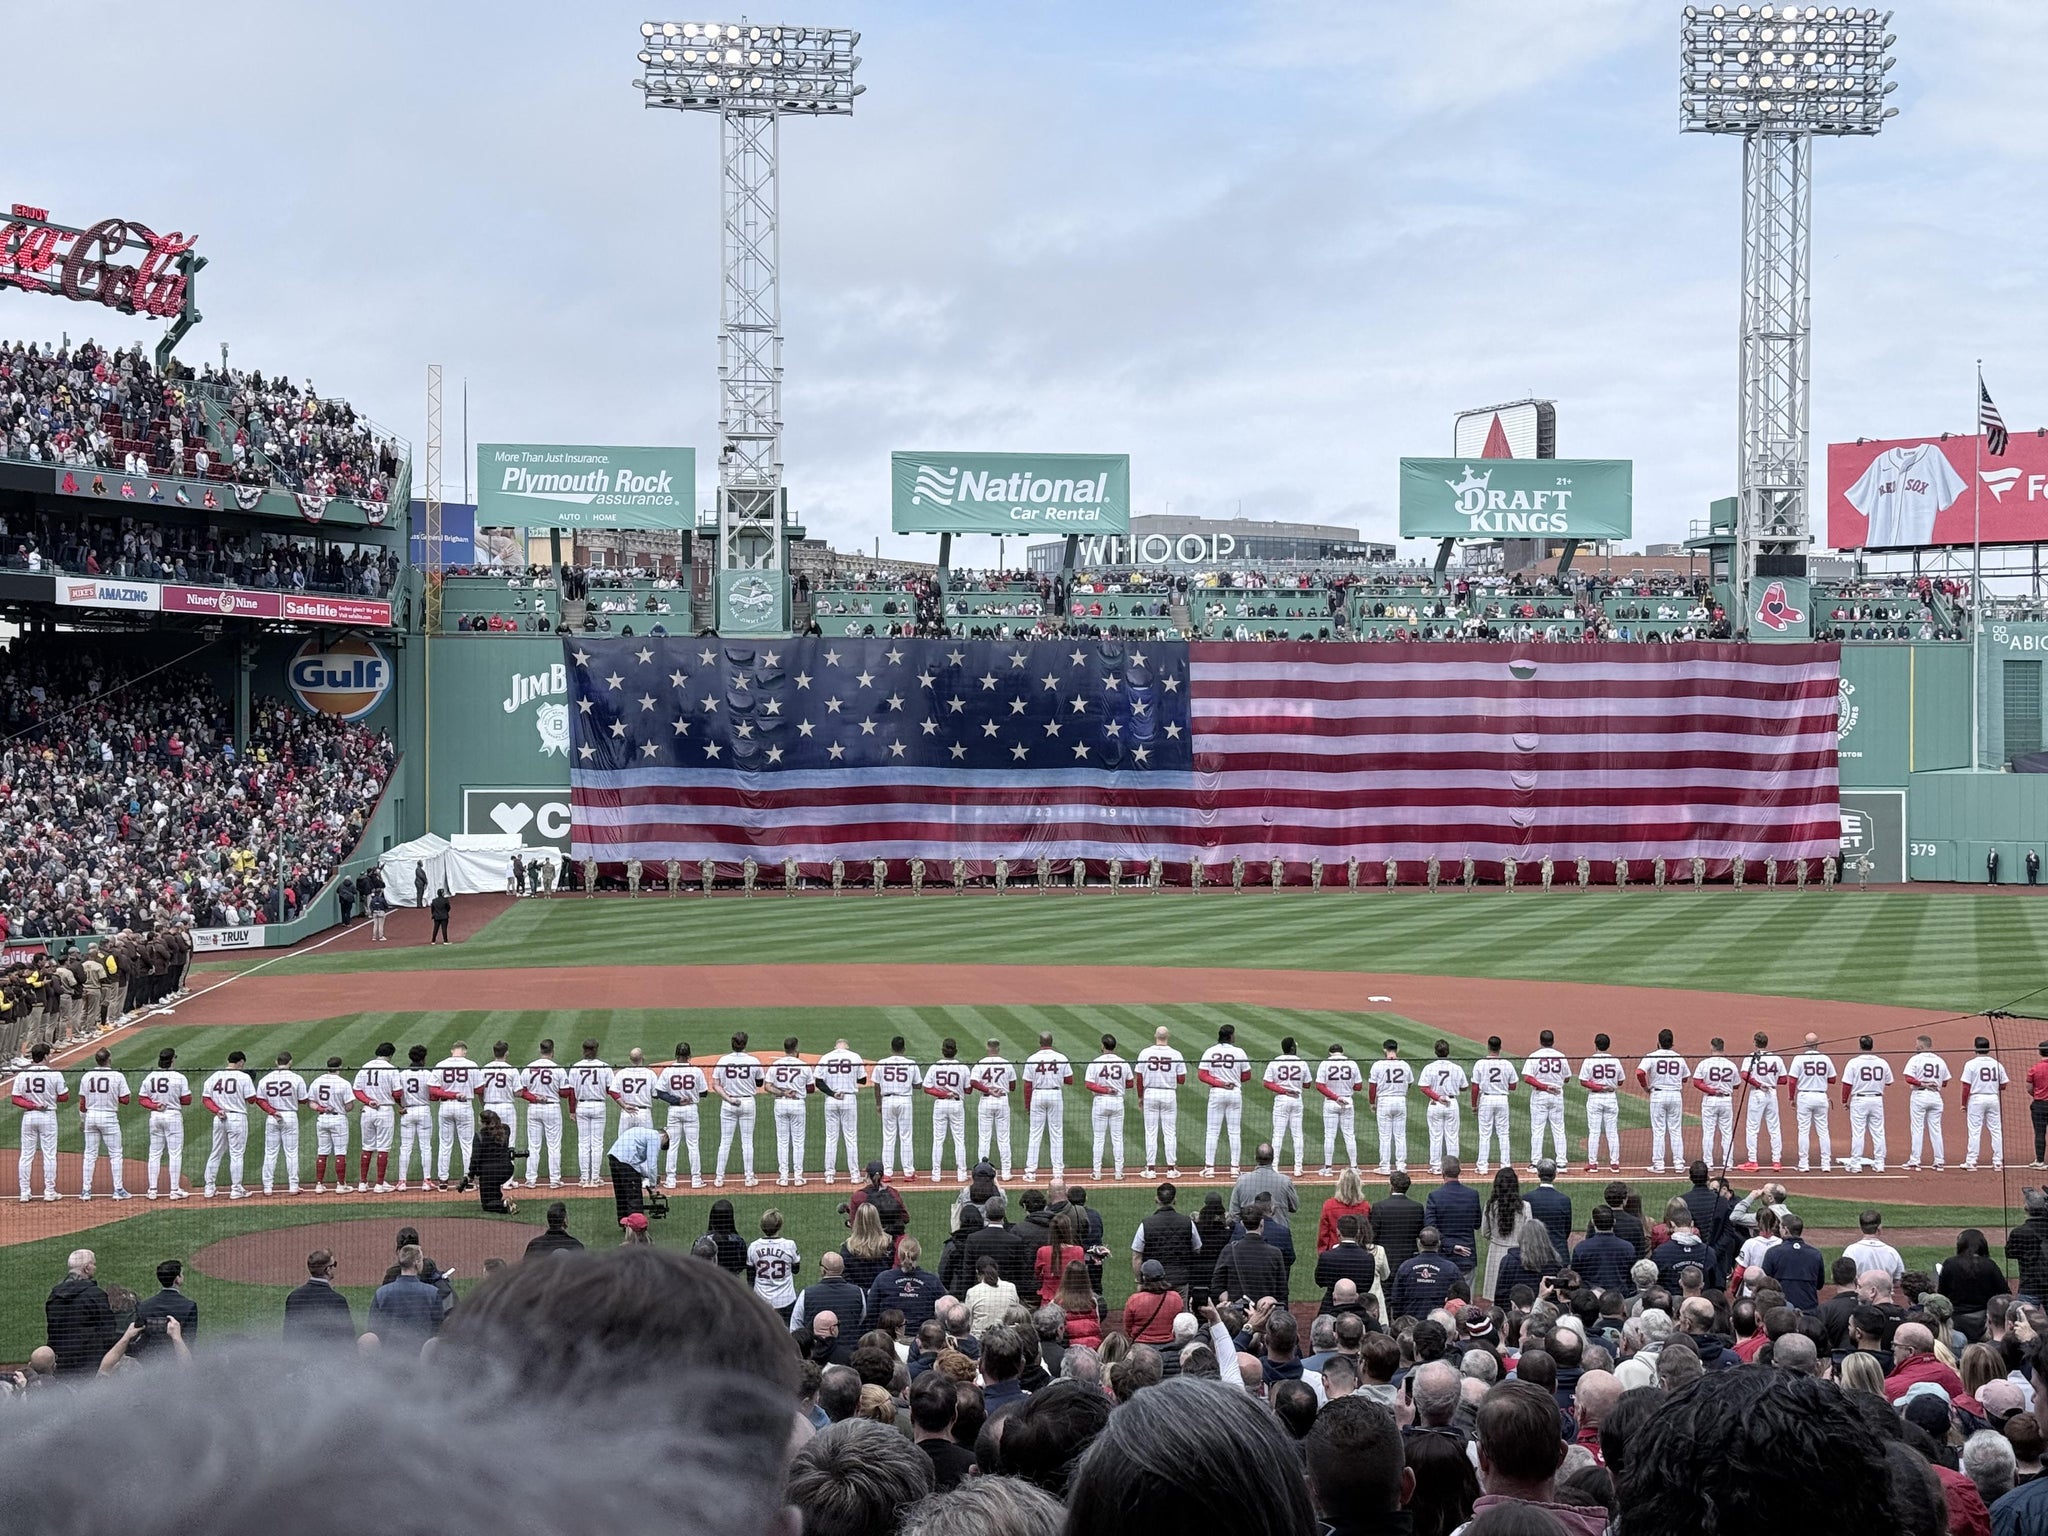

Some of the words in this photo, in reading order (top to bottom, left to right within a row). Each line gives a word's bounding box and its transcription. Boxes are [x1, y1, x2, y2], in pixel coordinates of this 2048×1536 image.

[15, 205, 49, 221] ENJOY
[495, 451, 518, 463] More
[521, 451, 543, 463] Than
[545, 452, 563, 463] Just
[565, 453, 609, 464] Insurance.
[501, 467, 609, 493] Plymouth
[615, 470, 672, 493] Rock
[957, 471, 1106, 503] National
[1905, 479, 1930, 495] SOX
[596, 493, 672, 505] assurance
[1455, 488, 1572, 514] DRAFT
[559, 513, 580, 521] AUTO
[1010, 507, 1039, 520] Car
[1045, 508, 1100, 521] Rental
[1469, 511, 1568, 532] KINGS
[1079, 534, 1235, 565] WHOOP
[98, 587, 149, 603] AMAZING
[187, 594, 217, 607] Ninety
[236, 597, 258, 609] Nine
[286, 601, 338, 618] Safelite
[294, 660, 382, 687] Gulf
[503, 673, 550, 714] JIM
[1910, 843, 1937, 856] 379
[221, 930, 249, 942] TRULY
[1035, 1060, 1059, 1075] 44
[1098, 1065, 1122, 1080] 43
[1278, 1065, 1301, 1080] 32
[1328, 1066, 1352, 1080] 23
[1539, 1058, 1562, 1073] 33
[1592, 1064, 1616, 1079] 85
[1923, 1063, 1940, 1078] 91
[366, 1070, 379, 1086] 11
[580, 1069, 598, 1085] 71
[776, 1067, 801, 1082] 57
[883, 1067, 908, 1082] 55
[936, 1071, 960, 1087] 50
[982, 1067, 1005, 1082] 47
[1386, 1068, 1404, 1083] 12
[1438, 1070, 1450, 1086] 7
[1489, 1067, 1501, 1082] 2
[1861, 1066, 1884, 1081] 60
[89, 1077, 110, 1093] 10
[213, 1078, 237, 1094] 40
[265, 1081, 292, 1097] 52
[407, 1078, 419, 1093] 3
[622, 1078, 647, 1093] 67
[319, 1085, 331, 1101] 5
[756, 1260, 786, 1280] 23
